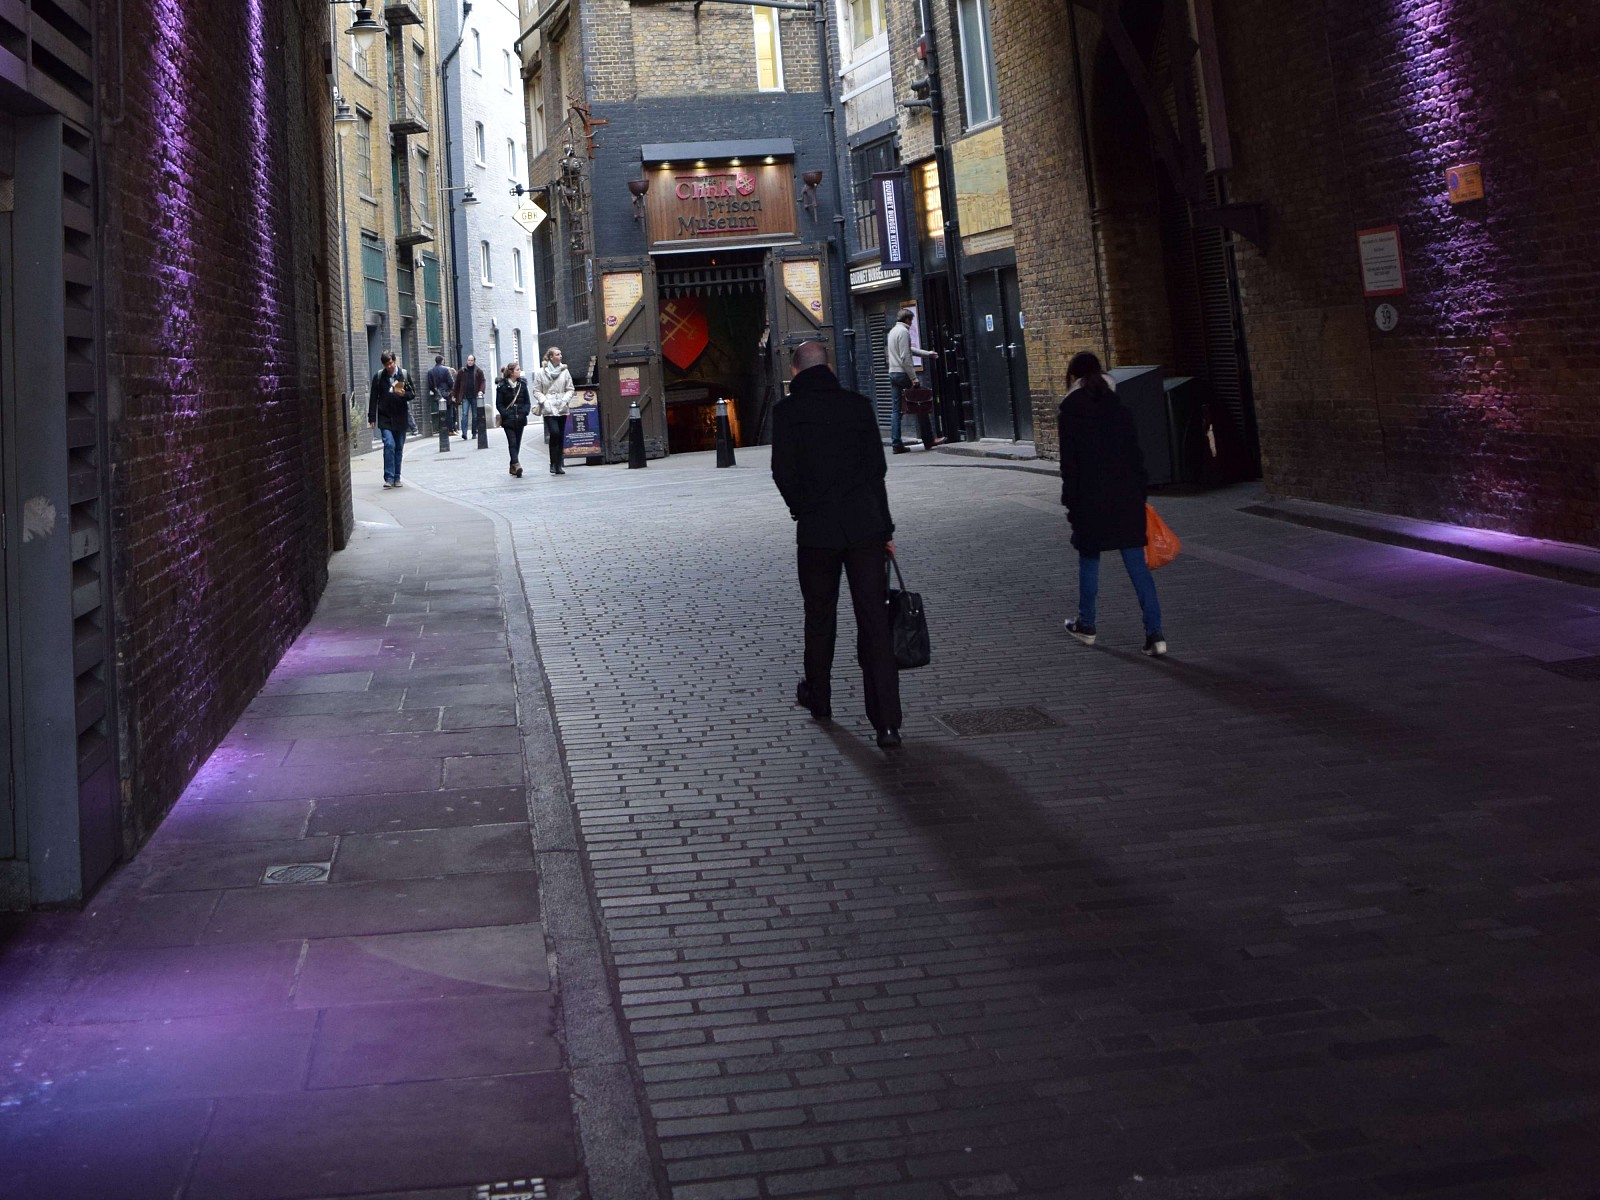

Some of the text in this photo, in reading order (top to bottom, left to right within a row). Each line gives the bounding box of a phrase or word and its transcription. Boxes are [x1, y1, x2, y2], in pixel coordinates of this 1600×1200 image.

[675, 179, 736, 200] Clink
[521, 211, 538, 220] GBK
[706, 199, 762, 218] Prison
[678, 215, 758, 236] Museum
[884, 180, 899, 262] GOURMET BURGER KITCHEN
[850, 270, 867, 285] GOURMET
[867, 266, 884, 282] BURGER
[1380, 310, 1392, 325] 39
